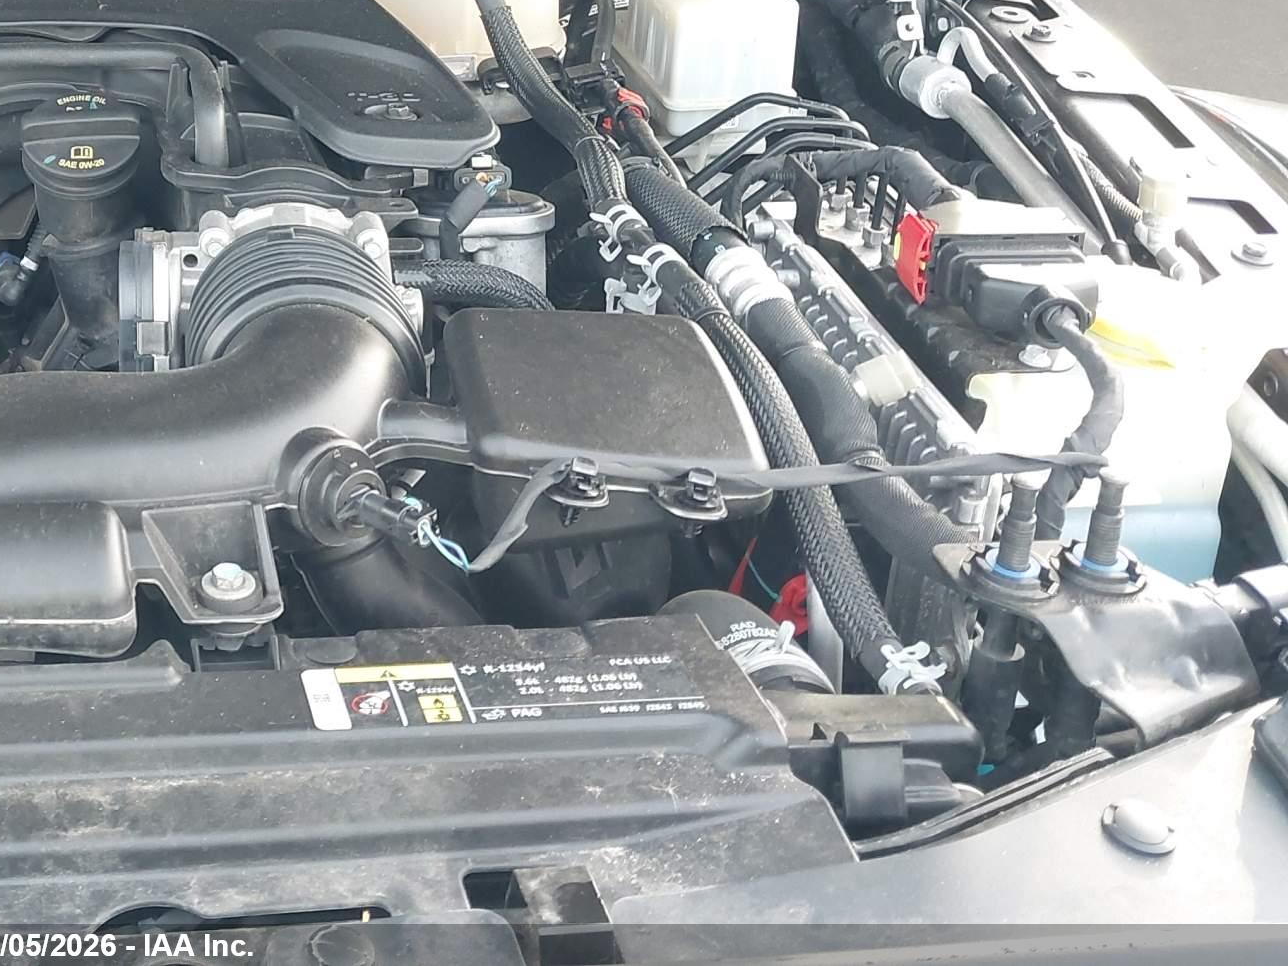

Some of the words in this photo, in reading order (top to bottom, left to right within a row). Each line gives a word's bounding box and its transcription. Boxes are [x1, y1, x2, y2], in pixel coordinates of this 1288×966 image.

[57, 95, 90, 105] ENGINE
[91, 96, 106, 105] OIL
[58, 159, 78, 169] SAE
[78, 158, 105, 169] 0W-20
[730, 621, 756, 632] RAD
[511, 708, 543, 719] PAG
